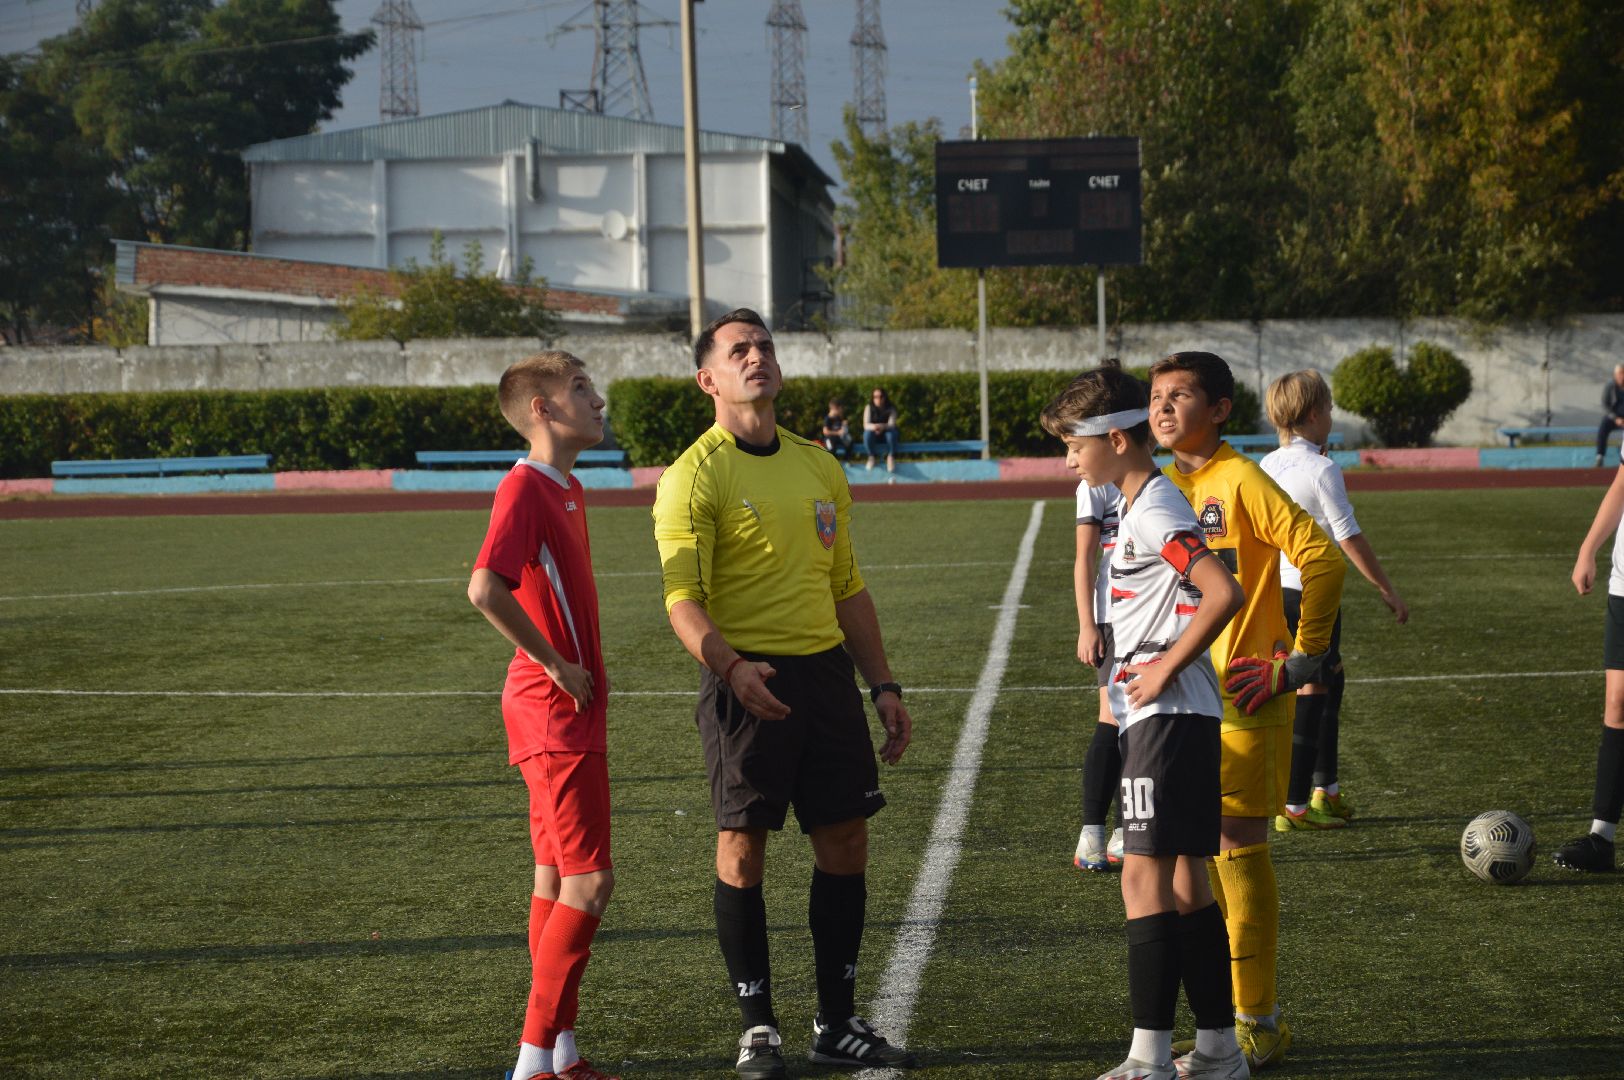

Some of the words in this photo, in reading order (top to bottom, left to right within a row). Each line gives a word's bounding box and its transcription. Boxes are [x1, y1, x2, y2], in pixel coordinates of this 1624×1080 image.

[957, 178, 989, 191] СЧЕТ
[1089, 175, 1120, 188] СЧЕТ
[1121, 777, 1155, 820] 30
